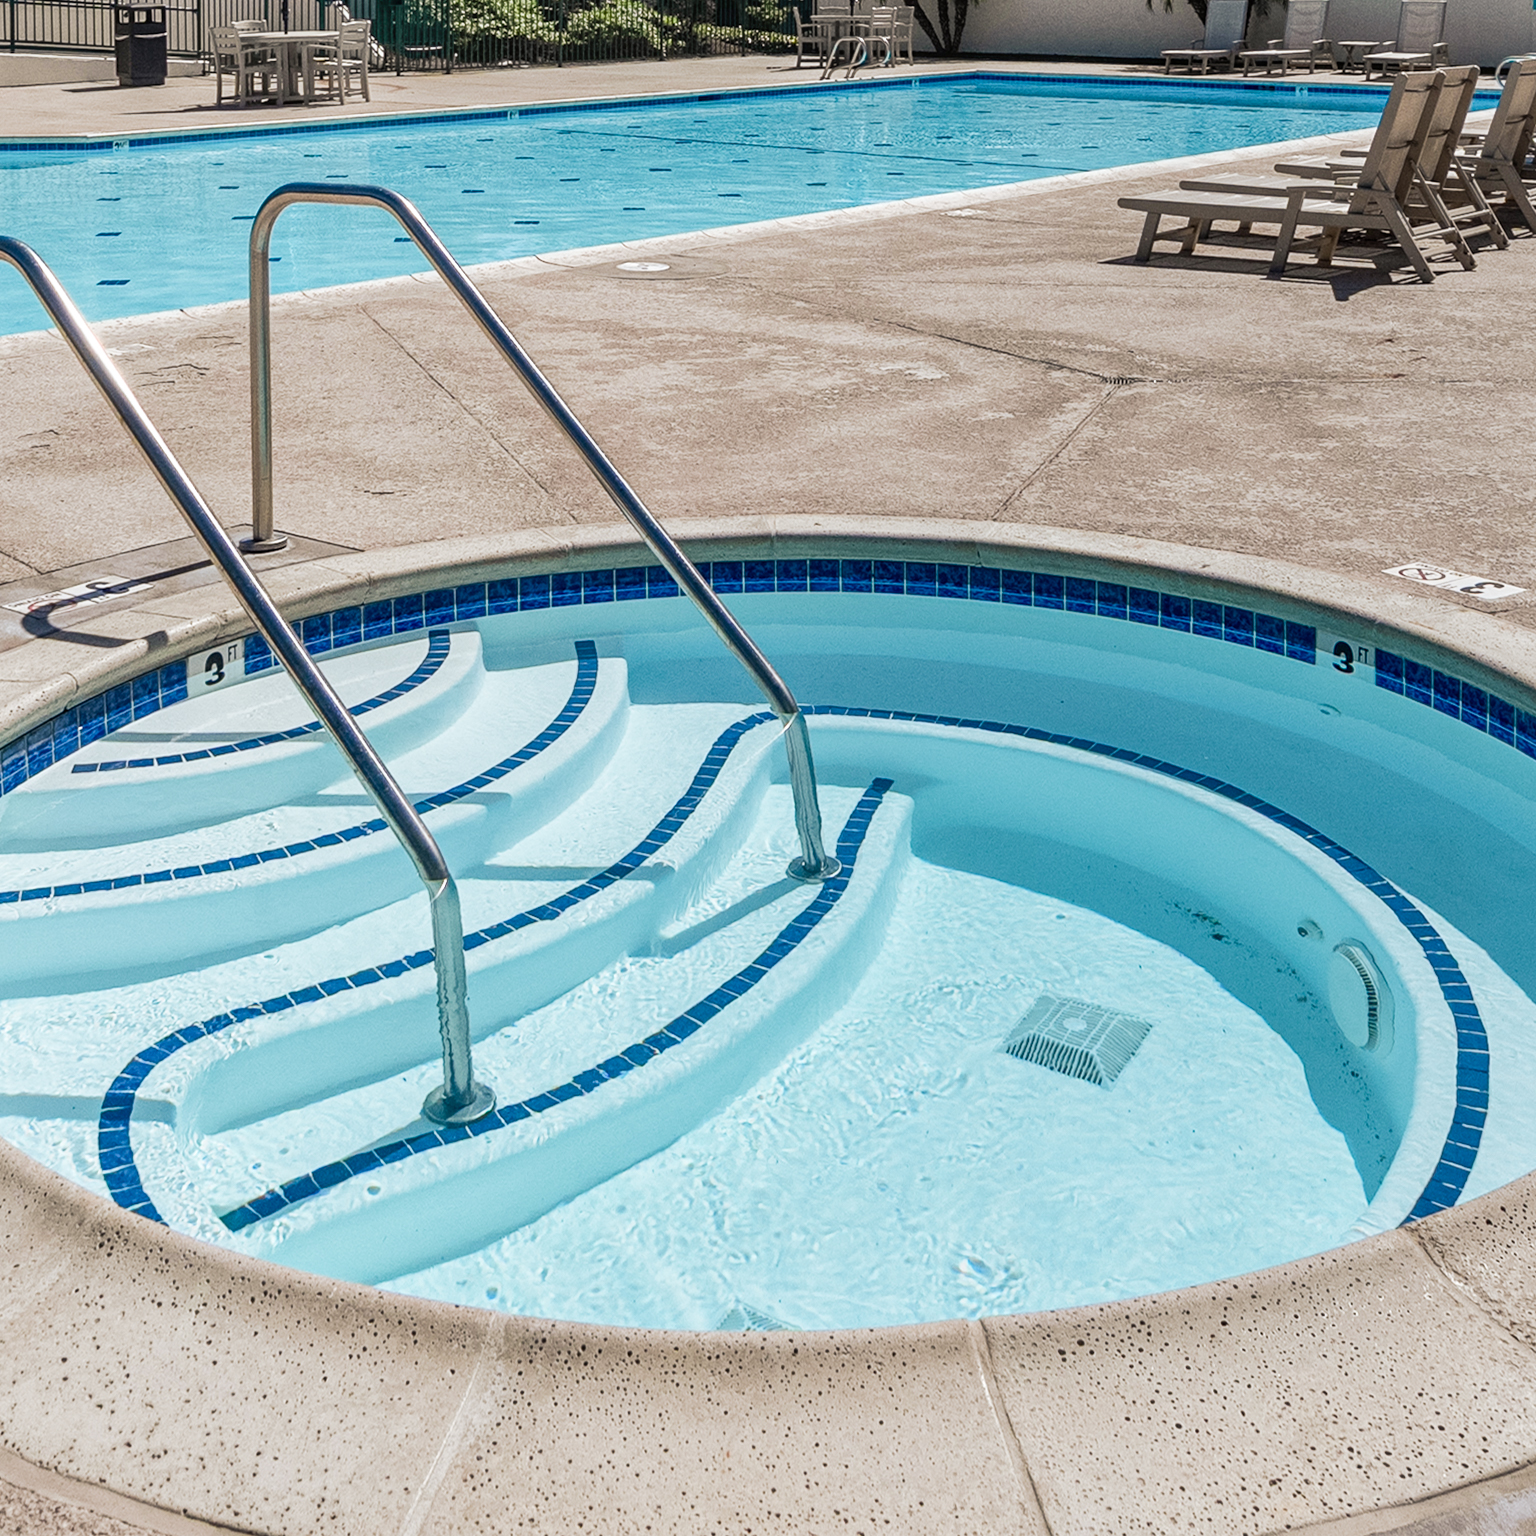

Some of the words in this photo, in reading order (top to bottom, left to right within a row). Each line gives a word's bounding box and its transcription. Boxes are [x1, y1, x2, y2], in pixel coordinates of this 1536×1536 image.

[204, 651, 225, 686] 3
[227, 644, 238, 662] FT
[1332, 640, 1355, 674] 3
[1358, 646, 1369, 664] FT
